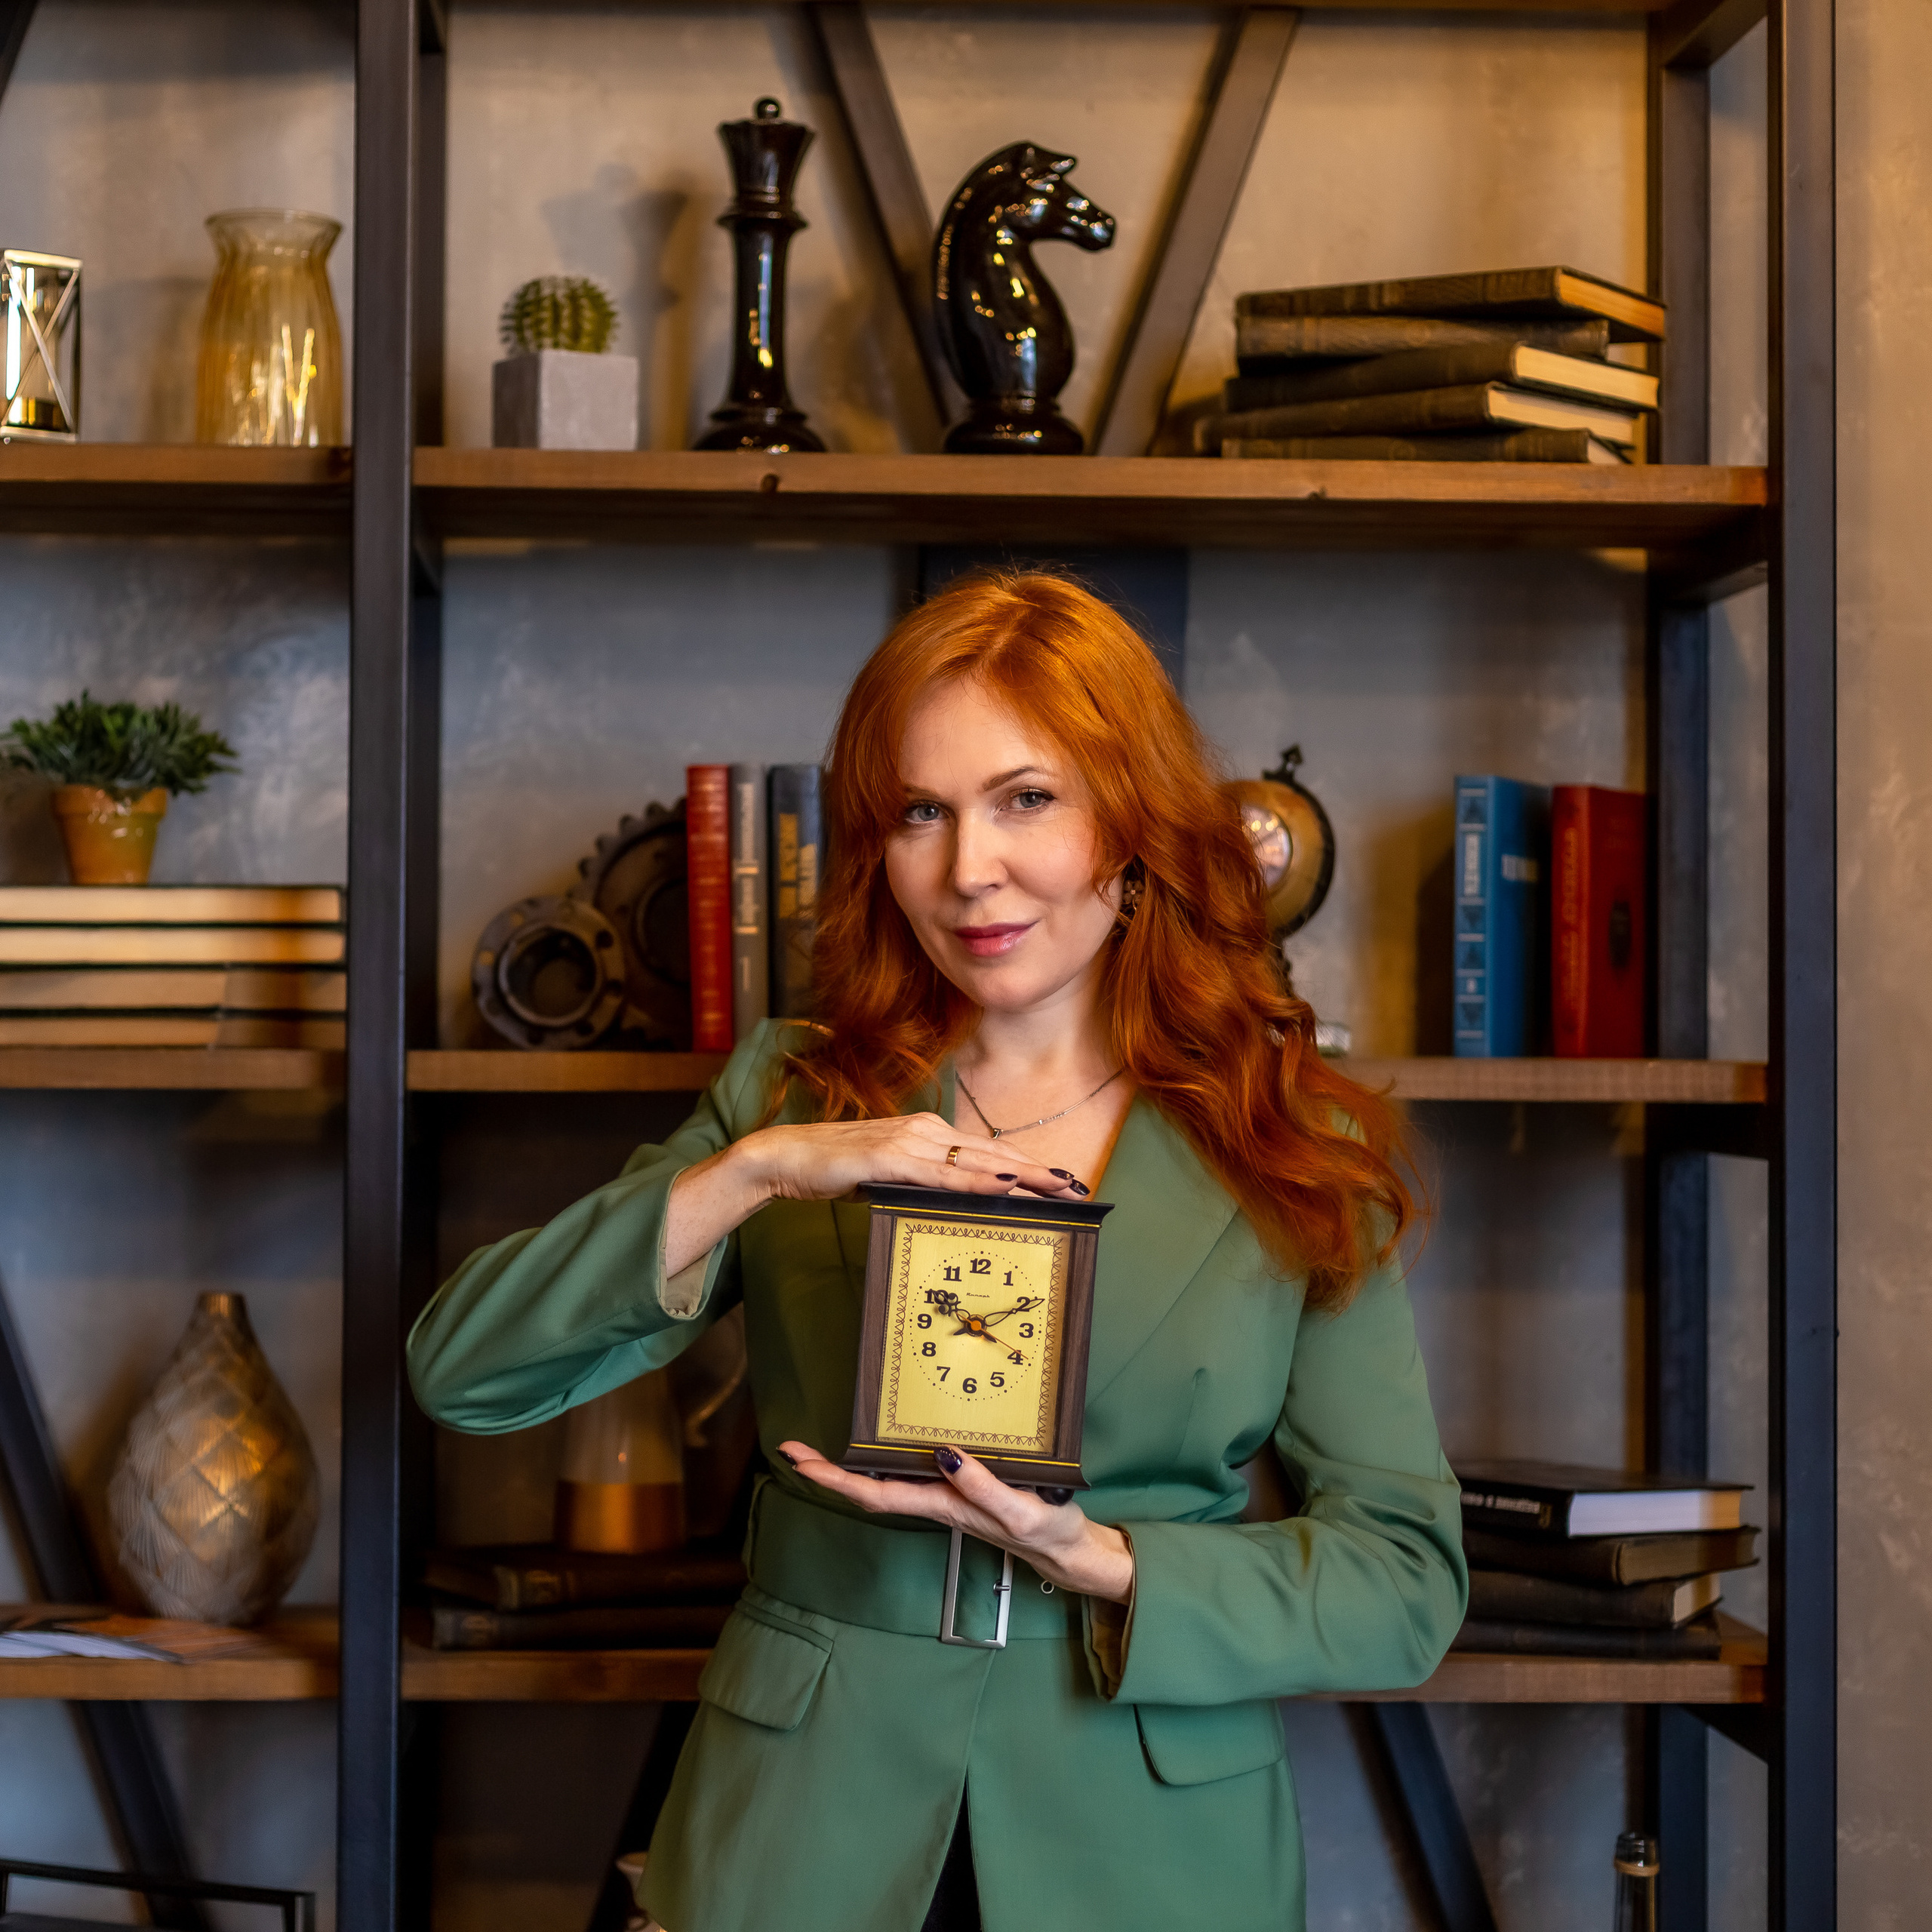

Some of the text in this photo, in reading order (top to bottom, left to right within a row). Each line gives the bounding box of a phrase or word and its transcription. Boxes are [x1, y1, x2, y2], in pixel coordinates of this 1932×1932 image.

[943, 1266, 961, 1281] 11
[970, 1258, 992, 1275] 12
[1003, 1271, 1014, 1286] 1
[924, 1288, 949, 1305] 10
[1017, 1297, 1031, 1312] 2
[917, 1314, 932, 1329] 9
[1019, 1323, 1034, 1338] 3
[921, 1342, 937, 1357] 8
[1008, 1350, 1023, 1365] 4
[937, 1366, 951, 1382] 7
[990, 1372, 1004, 1387] 5
[962, 1377, 977, 1394] 6
